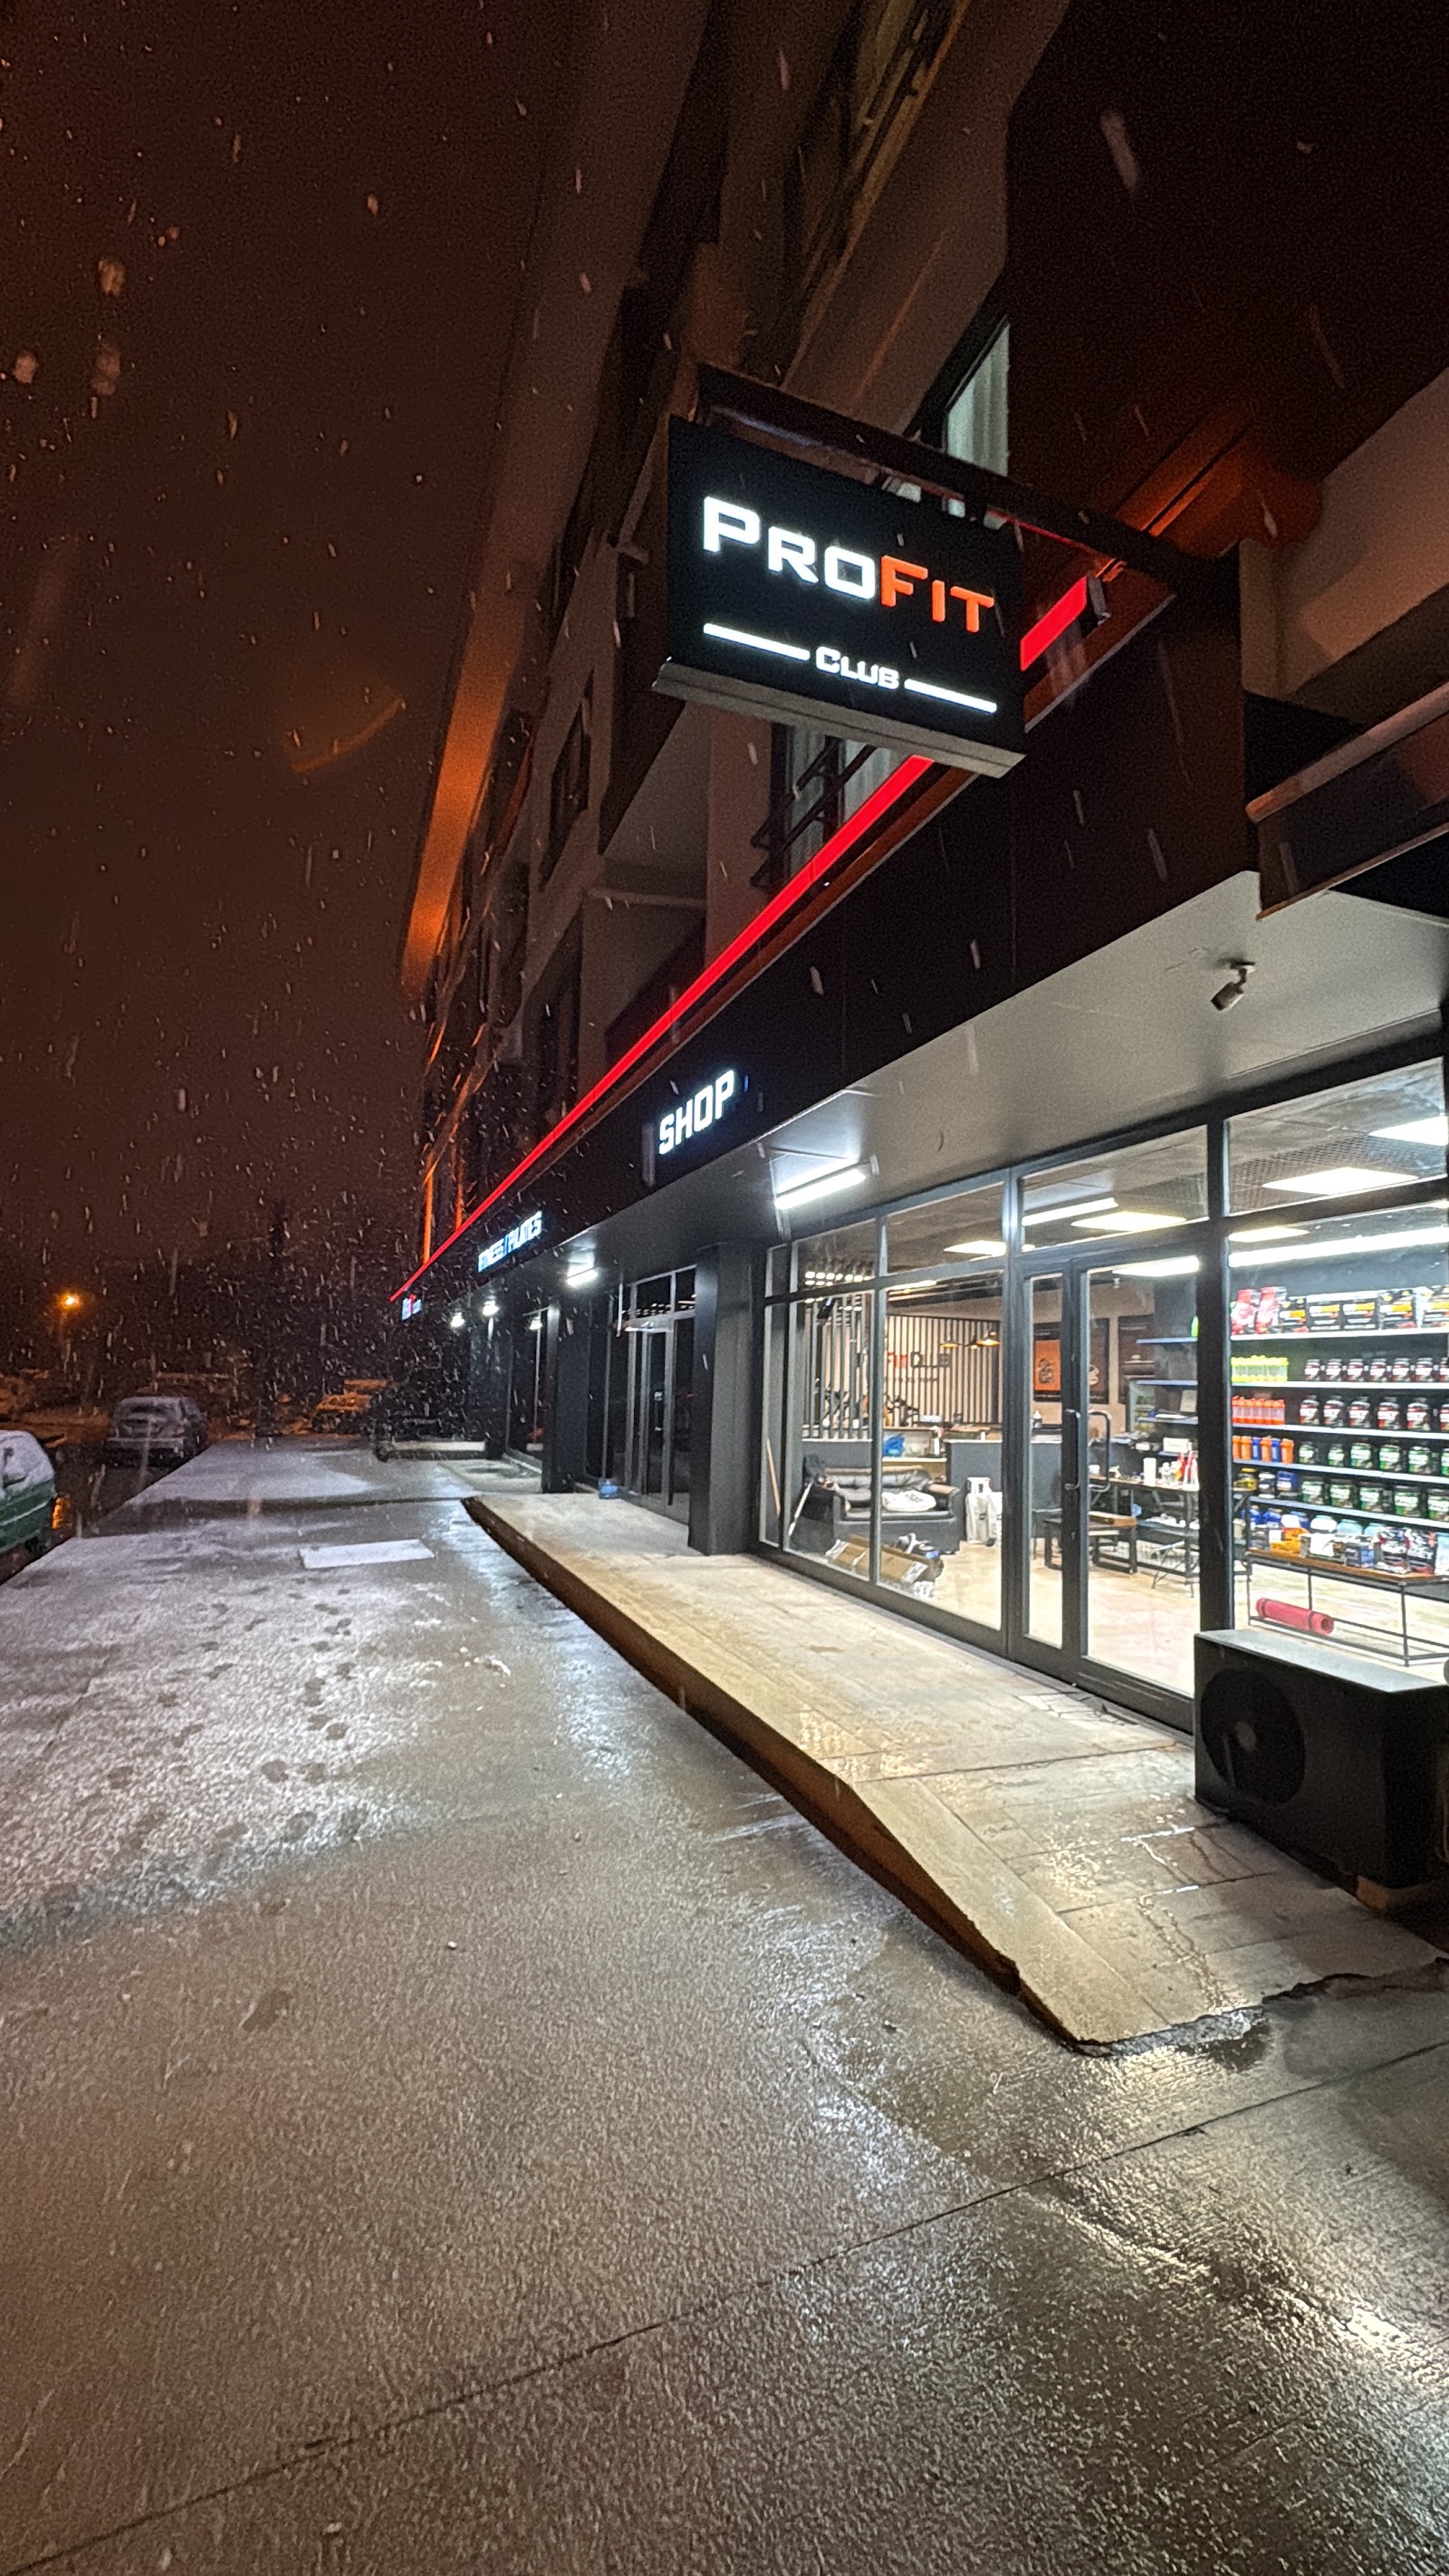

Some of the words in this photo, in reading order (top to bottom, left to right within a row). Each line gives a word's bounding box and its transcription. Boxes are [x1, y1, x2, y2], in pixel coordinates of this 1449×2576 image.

[703, 495, 994, 633] PROFIT
[815, 646, 899, 690] CLUB
[658, 1070, 734, 1155] SHOP
